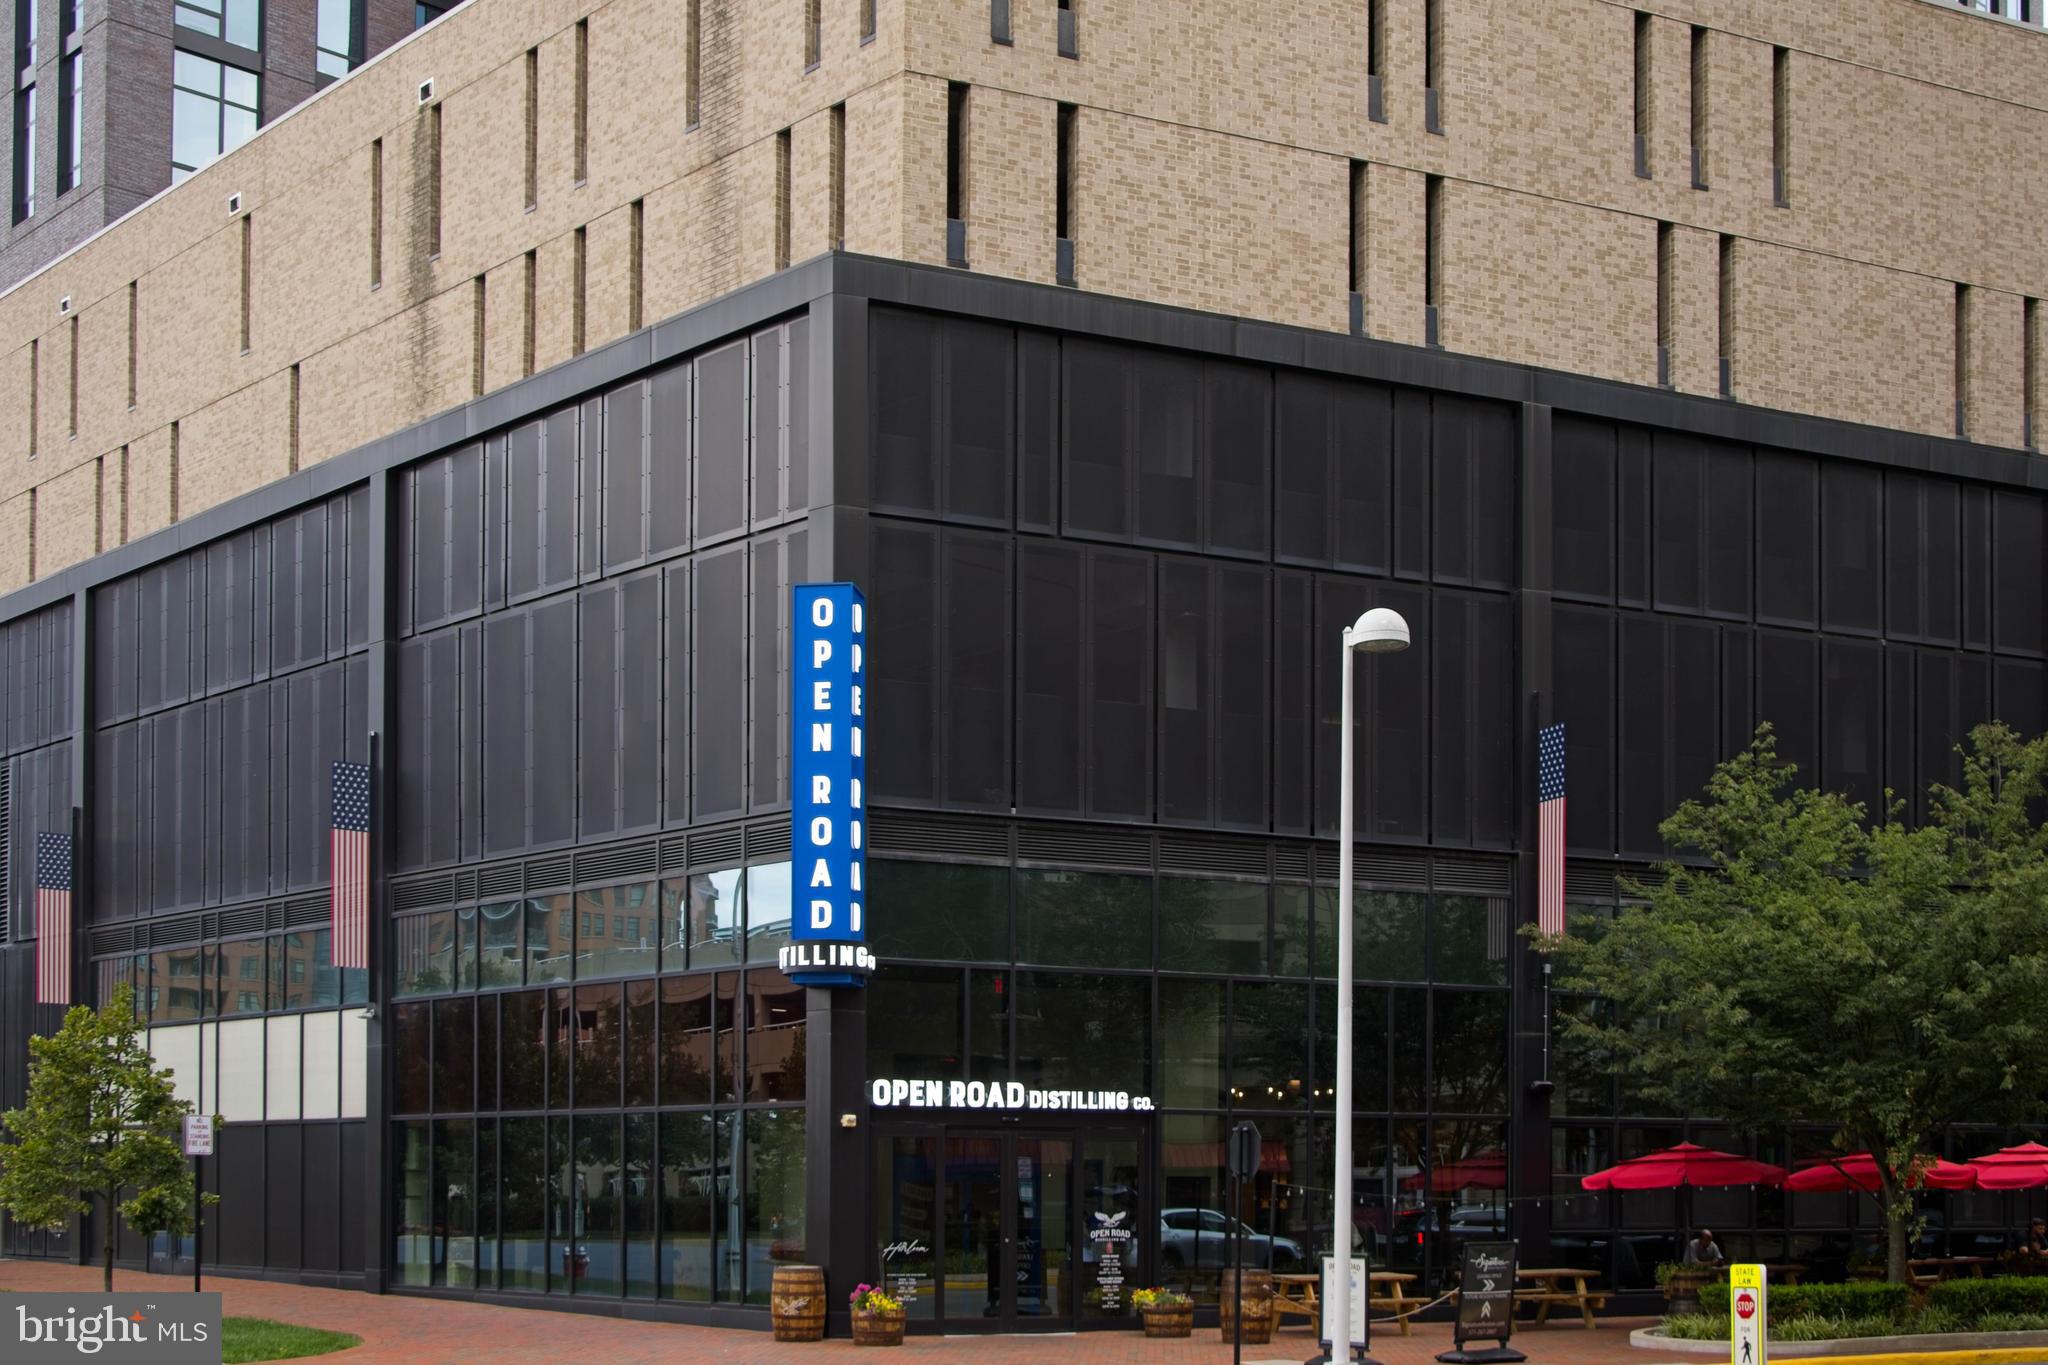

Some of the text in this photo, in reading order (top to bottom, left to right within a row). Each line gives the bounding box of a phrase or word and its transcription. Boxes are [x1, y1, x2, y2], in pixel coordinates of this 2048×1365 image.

[810, 597, 834, 929] OPEN ROAD
[872, 1079, 1155, 1110] OPEN ROAD DISTILLING CO.
[1090, 1229, 1131, 1239] OPEN ROAD
[1736, 1268, 1754, 1276] STATE
[1738, 1277, 1752, 1285] LAW
[1736, 1301, 1754, 1311] STOP
